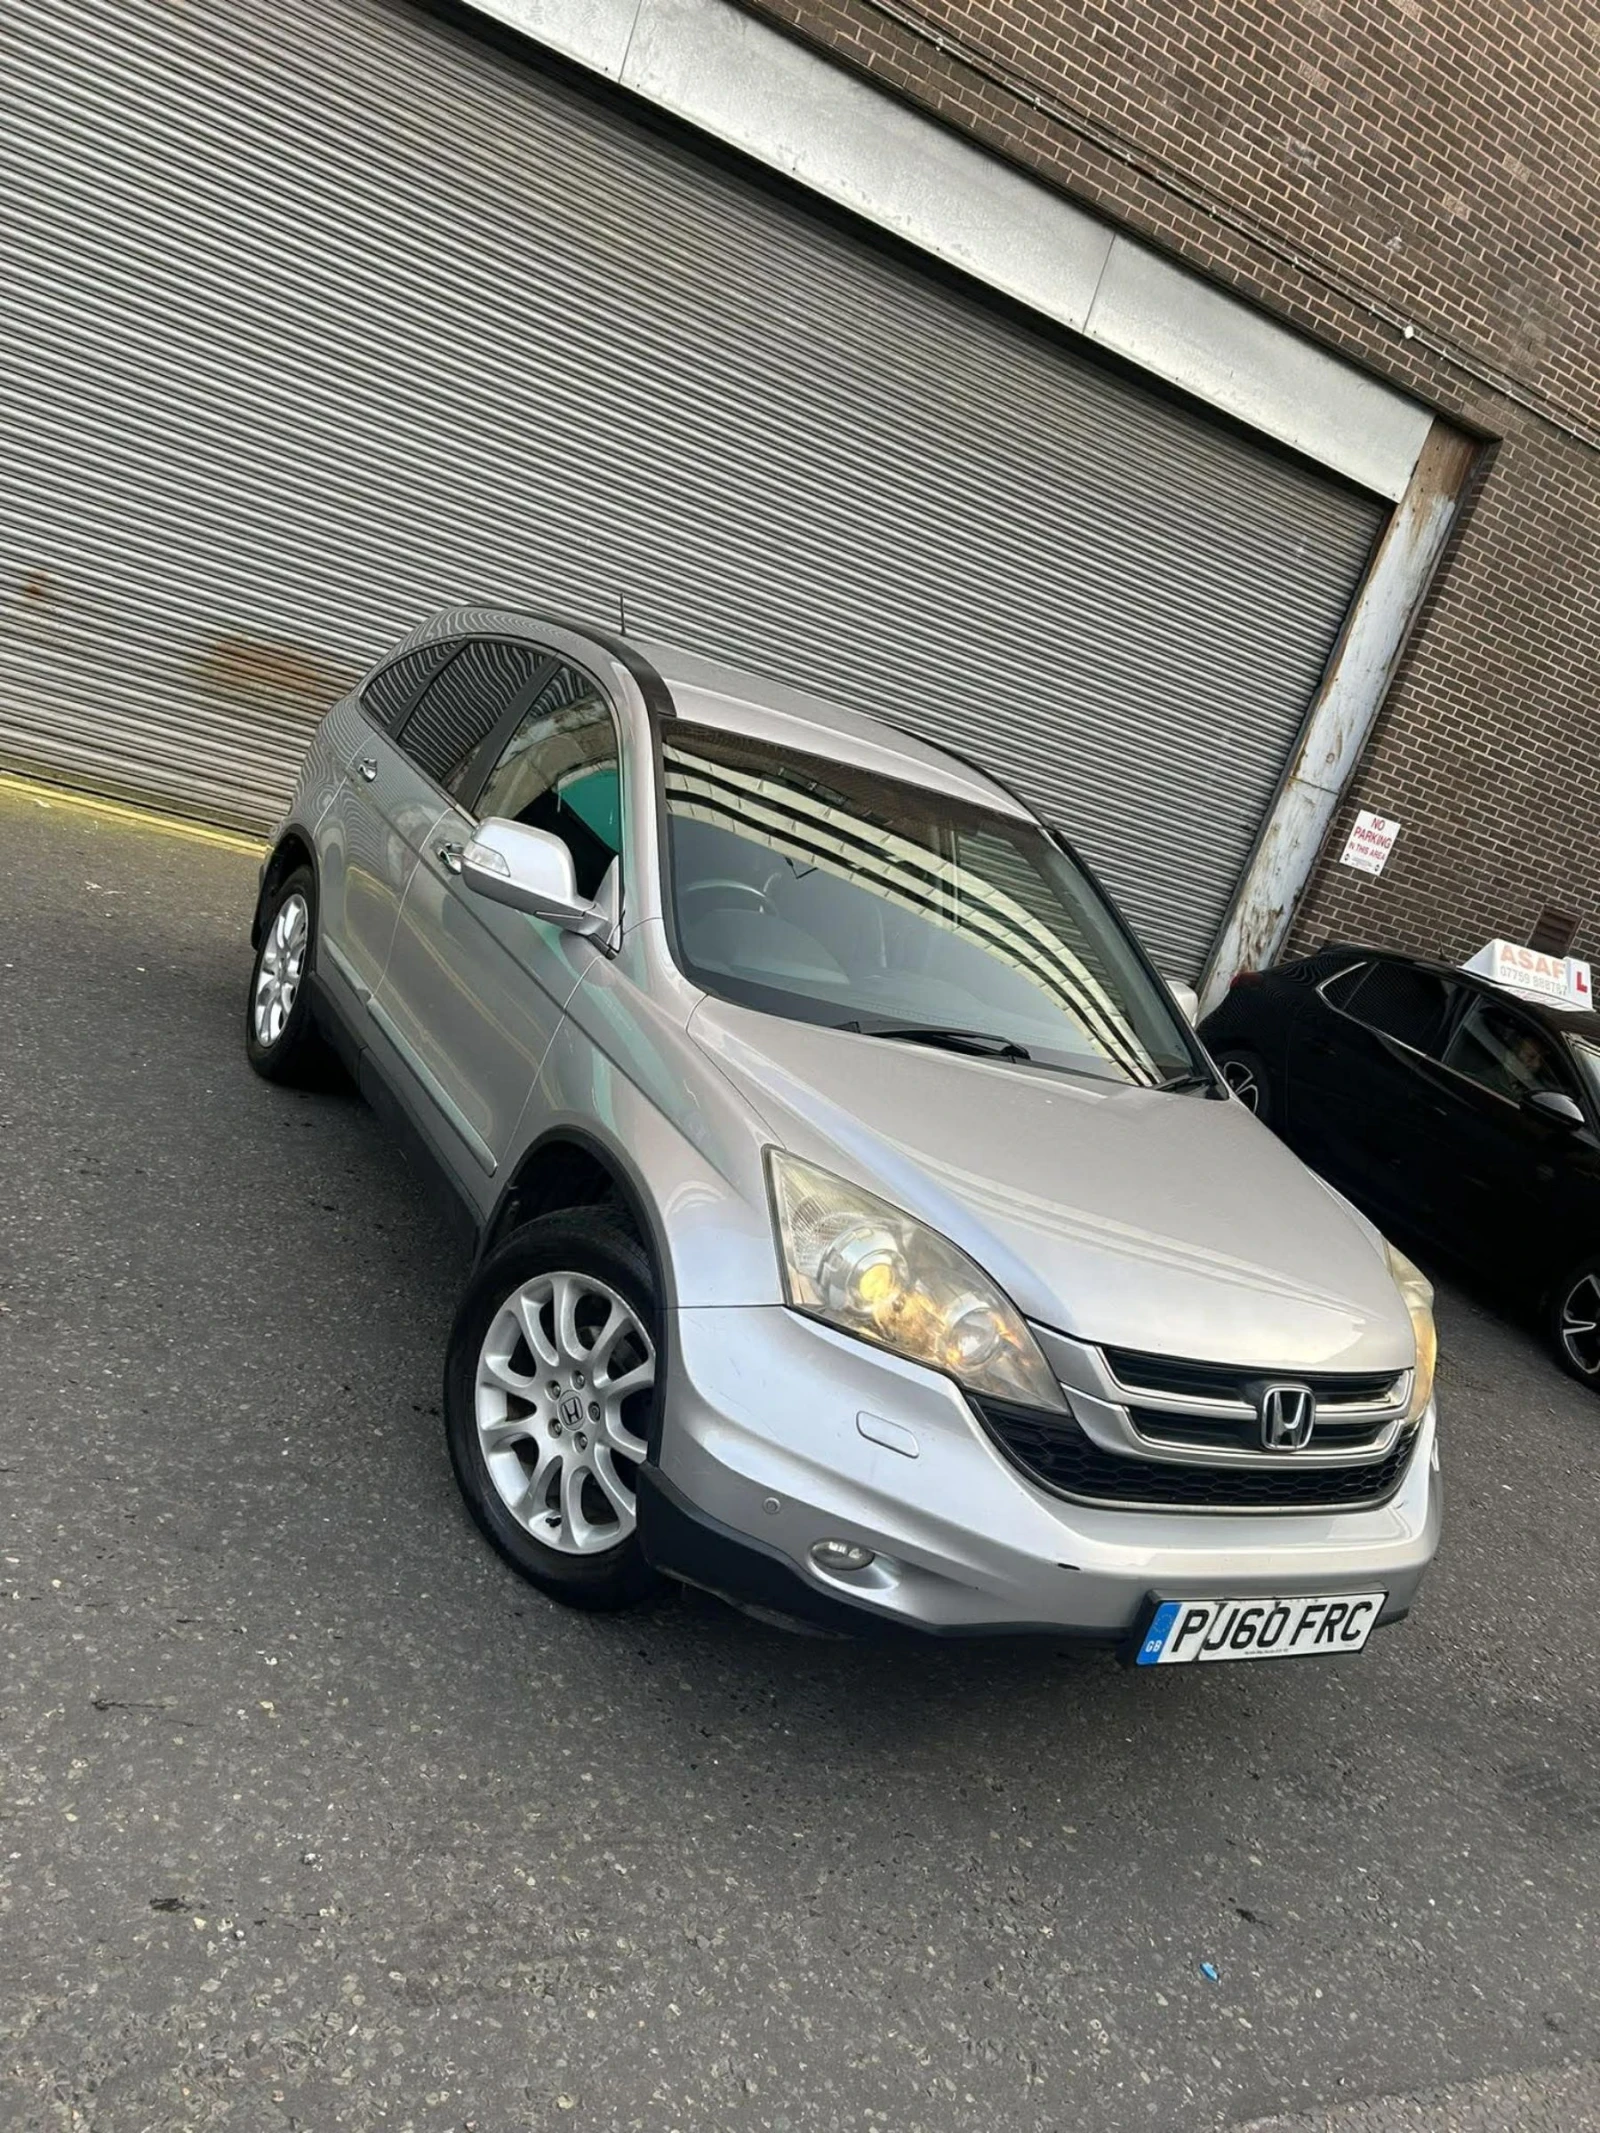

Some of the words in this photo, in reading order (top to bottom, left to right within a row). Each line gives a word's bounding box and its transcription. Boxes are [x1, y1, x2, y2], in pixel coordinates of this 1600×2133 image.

[1370, 817, 1386, 831] NO
[1353, 826, 1392, 849] PARKING
[1348, 841, 1355, 850] IN
[1356, 843, 1370, 855] THIS
[1370, 849, 1386, 860] AREA
[1500, 944, 1566, 979] ASAF
[1576, 971, 1588, 993] L
[1171, 1607, 1291, 1652] PJ60
[1289, 1601, 1373, 1645] FRC
[1145, 1640, 1162, 1653] GB
